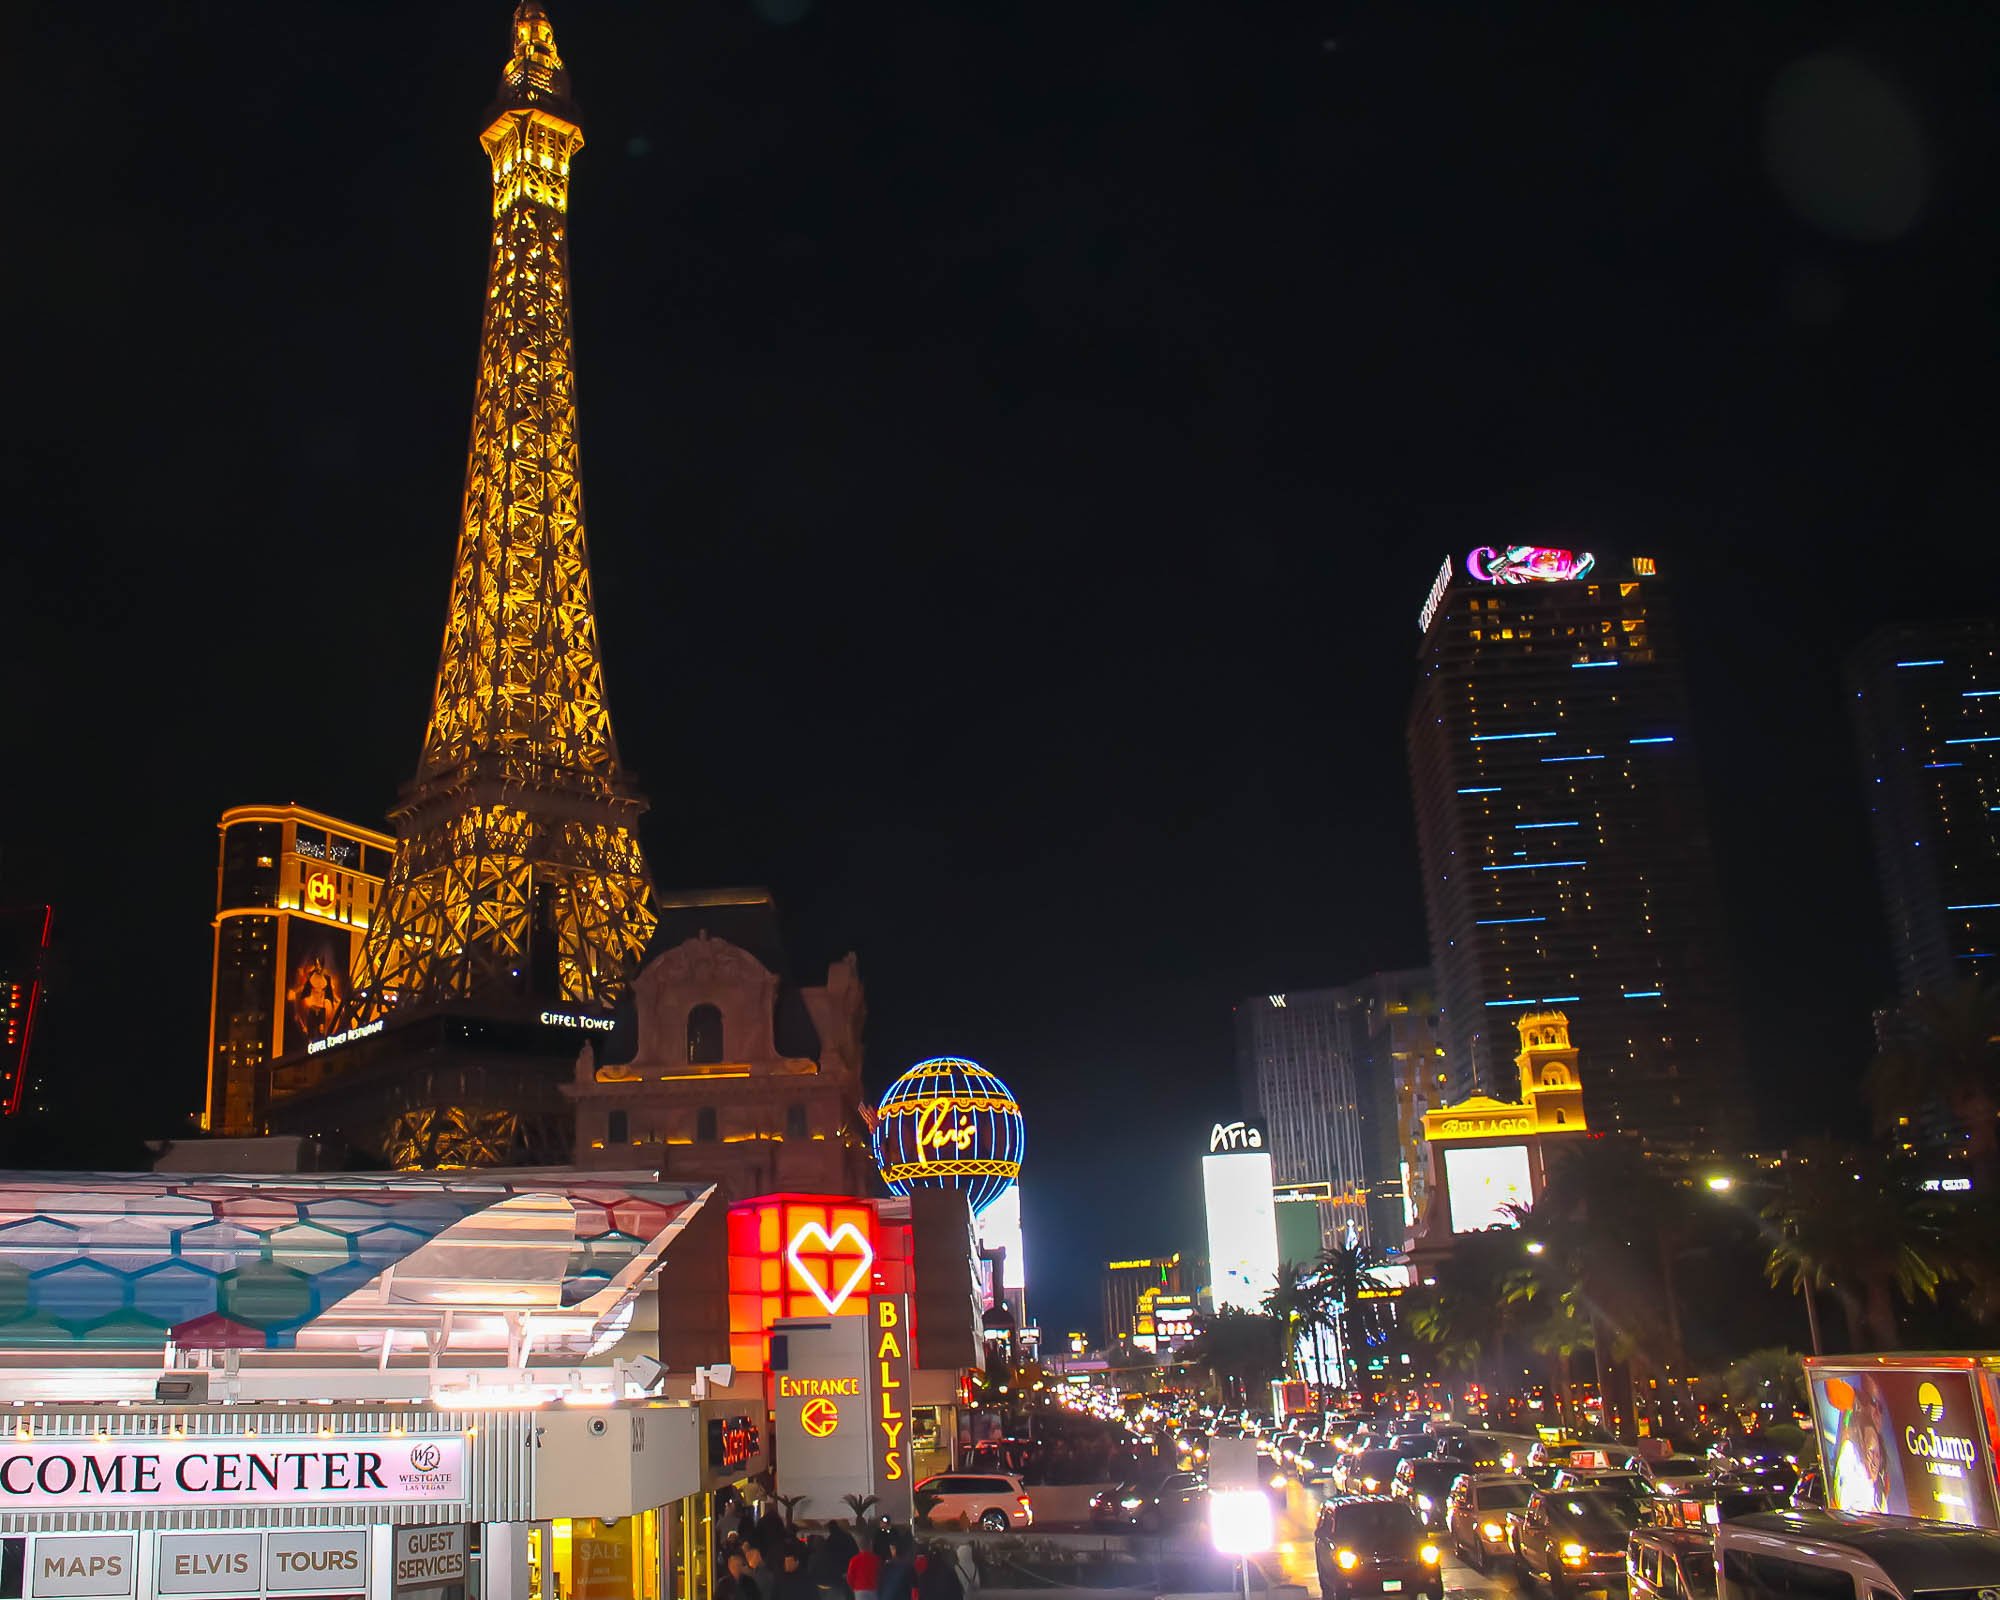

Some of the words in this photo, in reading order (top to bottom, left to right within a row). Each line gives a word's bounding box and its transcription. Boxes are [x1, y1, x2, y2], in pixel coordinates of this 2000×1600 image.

[1905, 1425, 1975, 1470] GoJump
[0, 1454, 162, 1495] COME
[175, 1452, 388, 1493] CENTER
[399, 1473, 452, 1483] WESTGATE
[408, 1531, 454, 1555] GUEST
[580, 1543, 625, 1560] SALE
[44, 1555, 122, 1578] MAPS
[175, 1553, 249, 1575] ELVIS
[276, 1550, 358, 1572] TOURS
[398, 1553, 463, 1580] SERVICES
